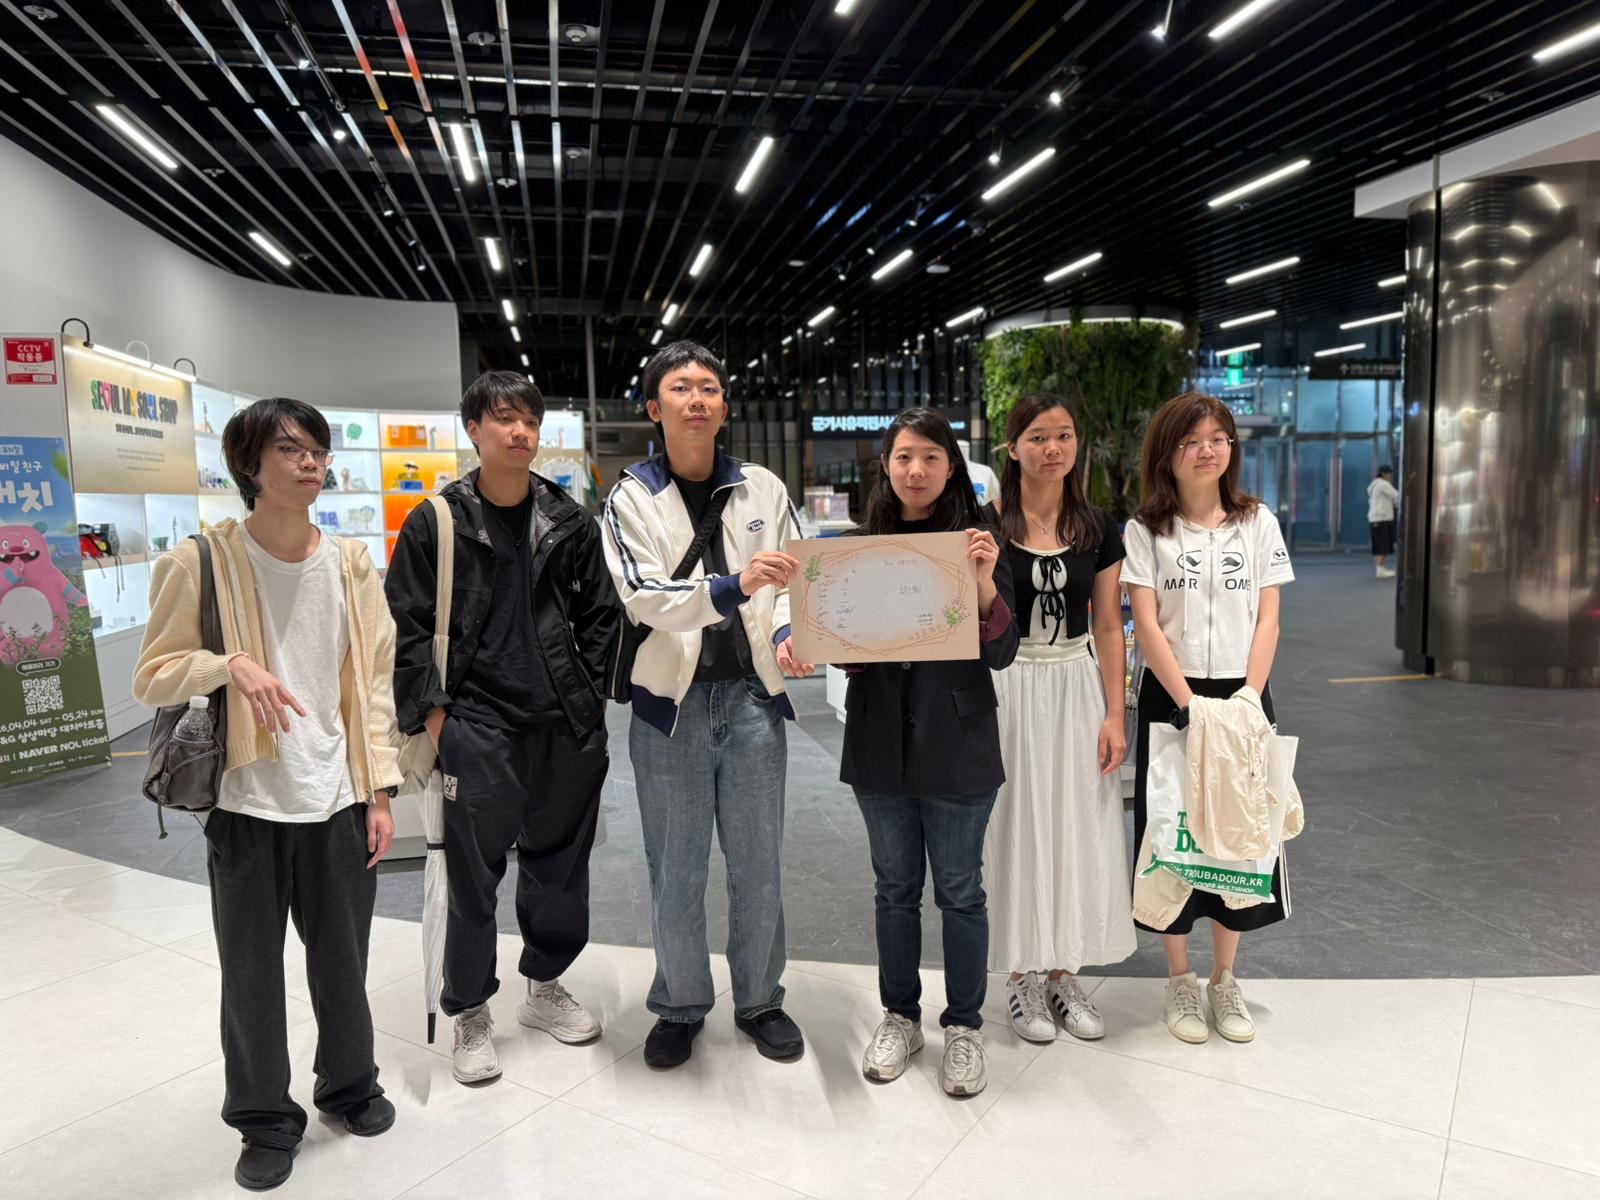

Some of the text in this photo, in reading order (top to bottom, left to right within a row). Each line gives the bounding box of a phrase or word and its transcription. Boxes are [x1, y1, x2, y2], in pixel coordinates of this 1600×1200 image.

[17, 344, 41, 352] CCTV
[21, 460, 42, 473] 친구
[0, 719, 37, 733] 6.04.04
[62, 710, 88, 721] 05.24
[18, 727, 58, 743] 상상마당
[60, 718, 105, 732] 대치아트홀
[19, 745, 58, 759] NAVER
[60, 741, 81, 751] NOL
[82, 735, 109, 747] ticket
